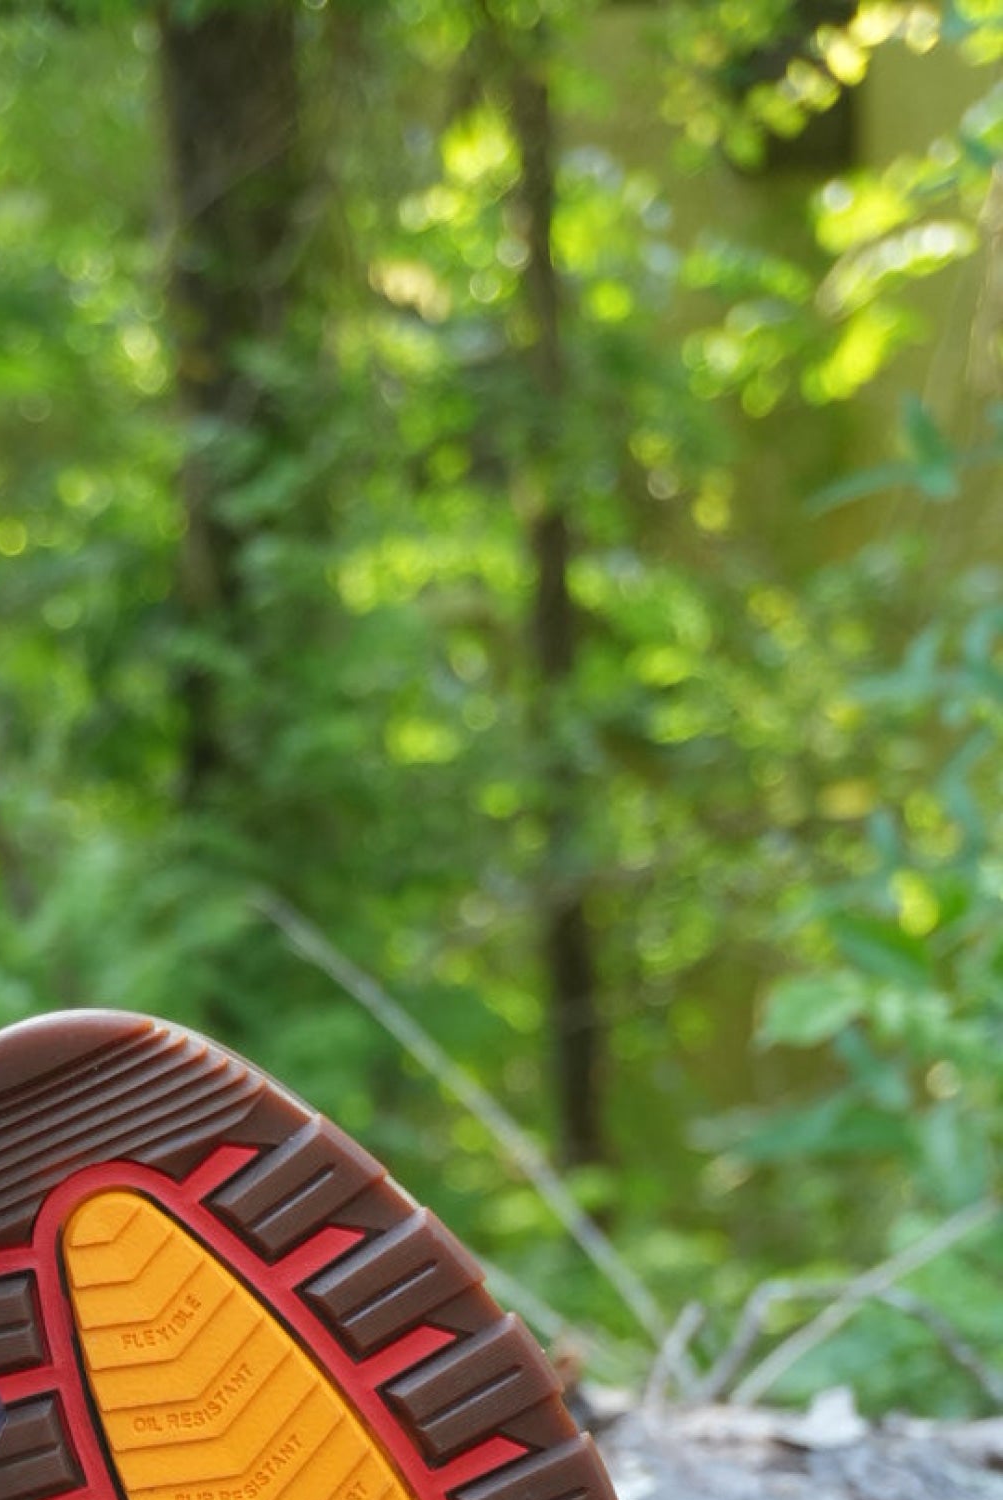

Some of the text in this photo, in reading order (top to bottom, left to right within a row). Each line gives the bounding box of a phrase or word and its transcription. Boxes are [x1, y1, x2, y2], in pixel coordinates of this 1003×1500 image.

[121, 1293, 203, 1350] FLEXIBLE
[133, 1362, 256, 1433] OIL RESISTANT
